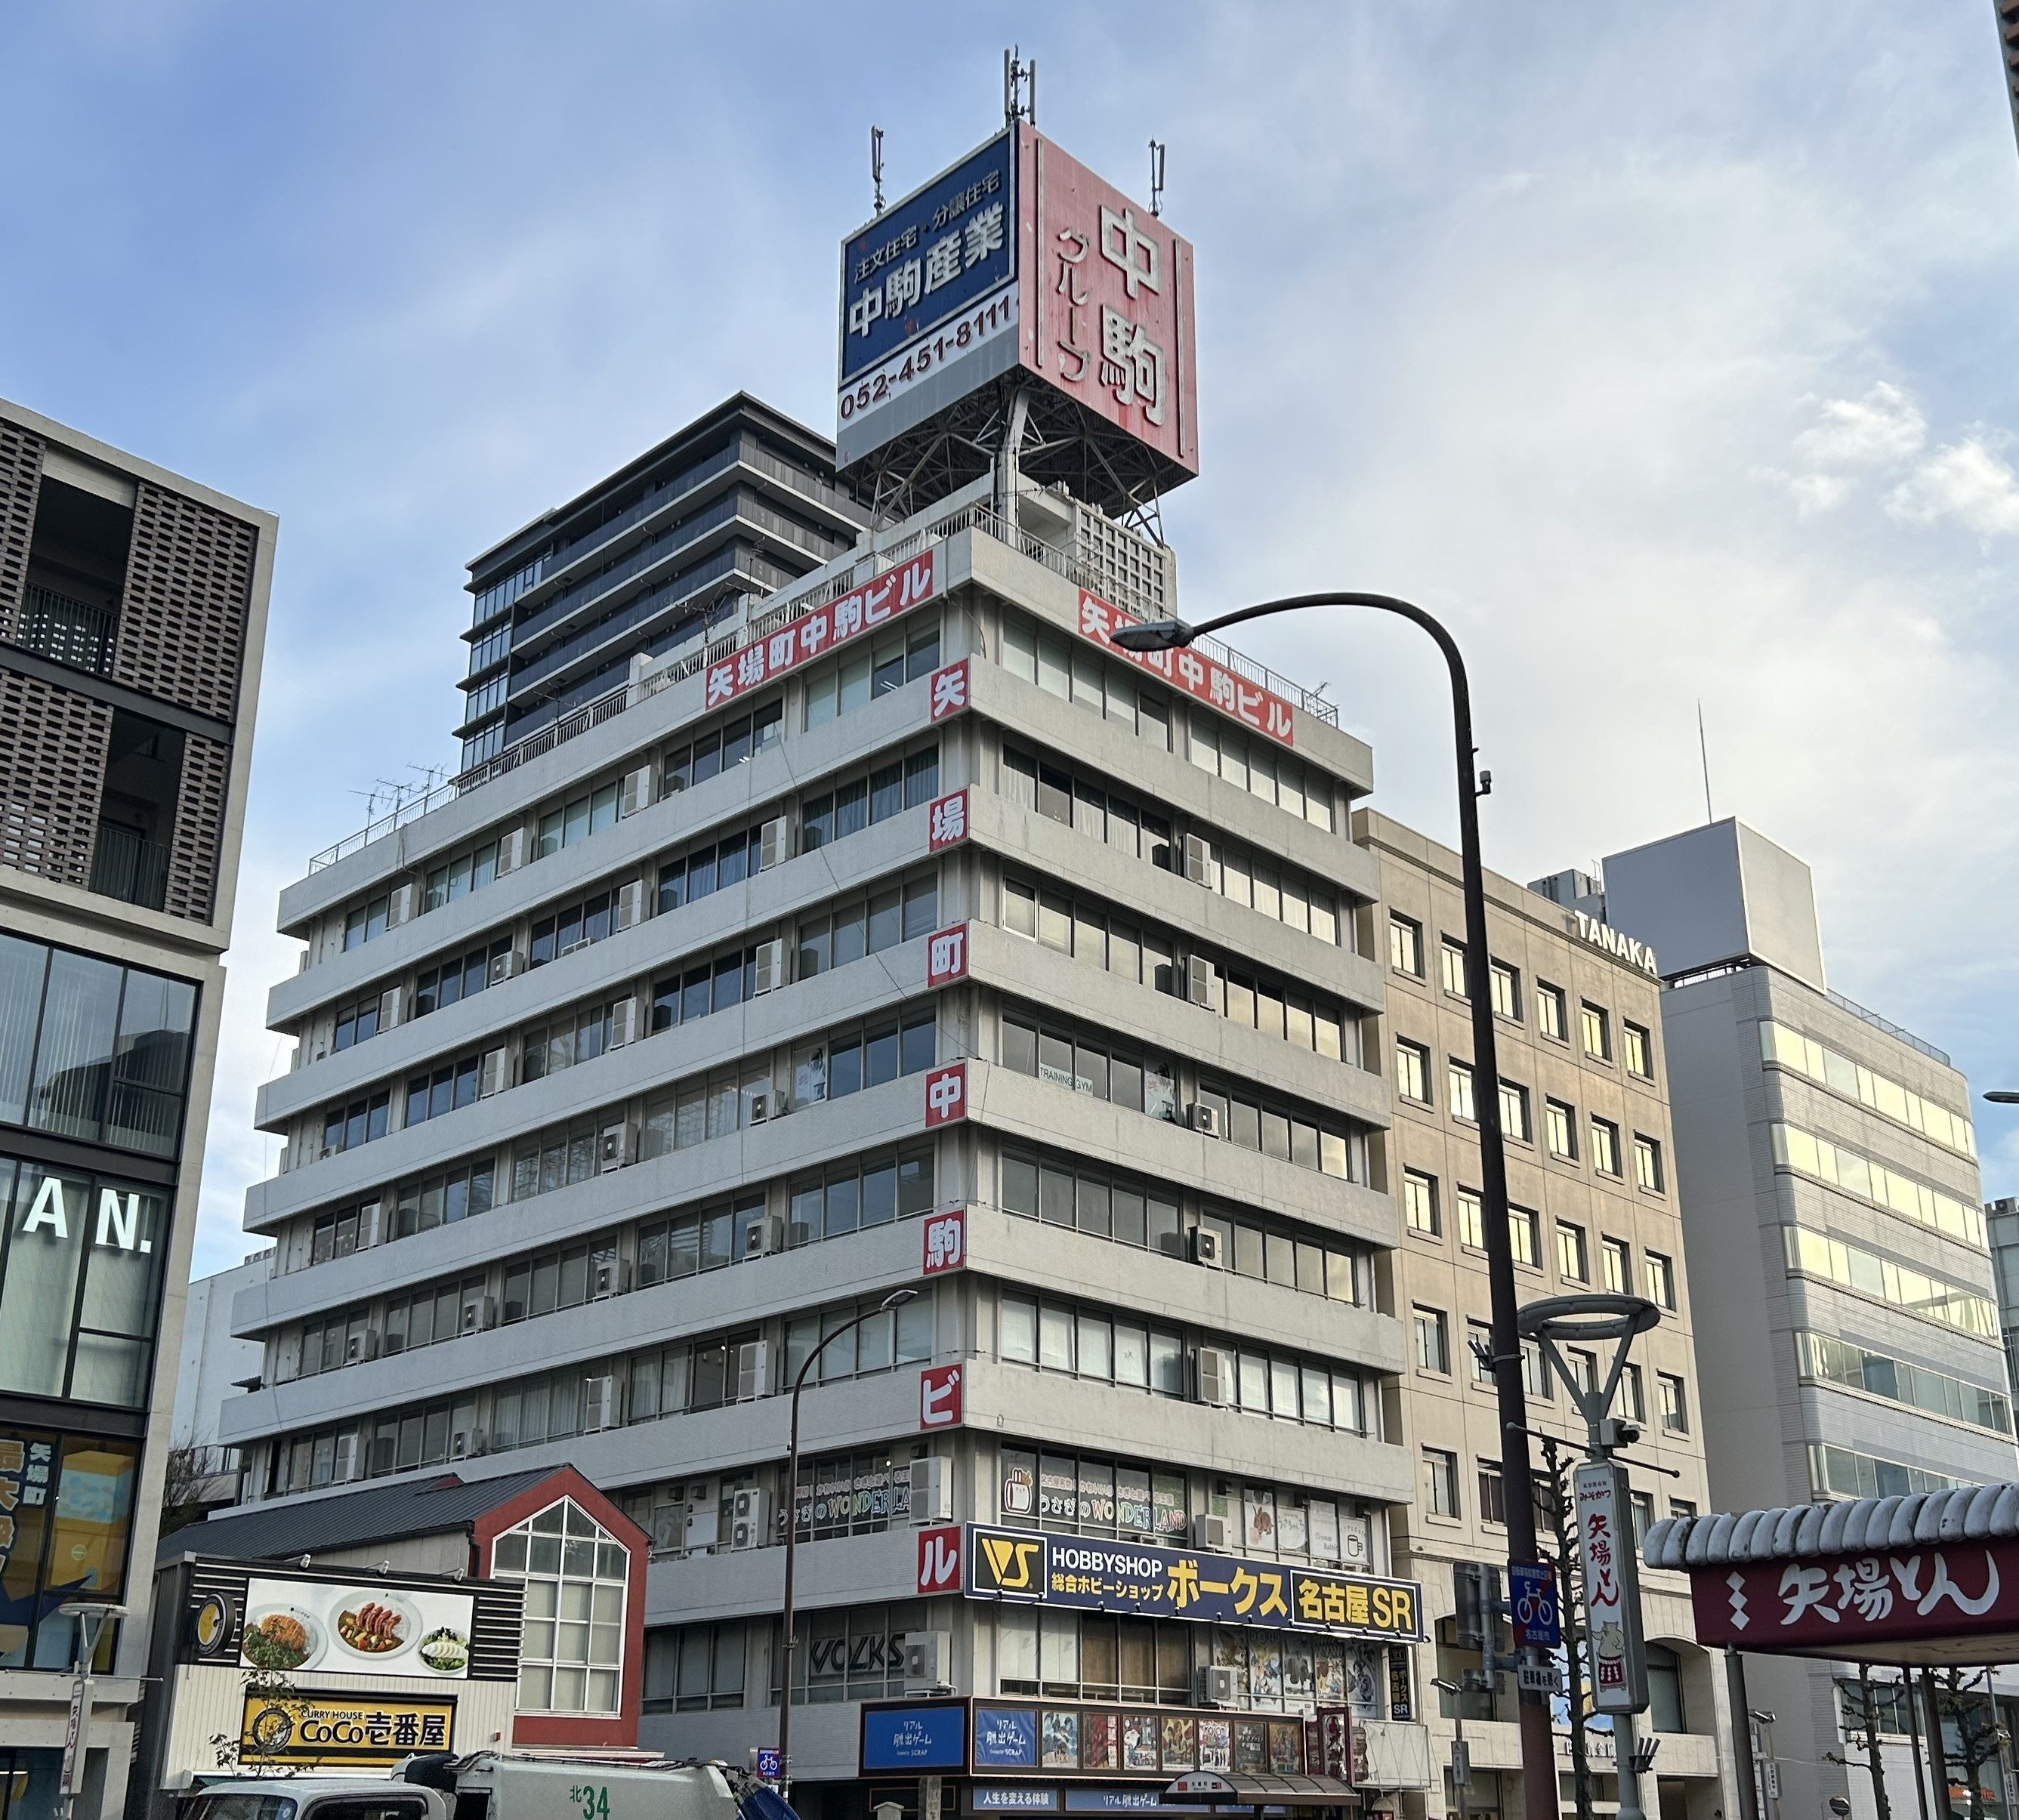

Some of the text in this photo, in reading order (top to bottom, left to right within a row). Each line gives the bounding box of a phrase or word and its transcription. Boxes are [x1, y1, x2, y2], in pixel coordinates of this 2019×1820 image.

[849, 201, 1004, 338] 中駒産業
[1058, 228, 1090, 382] グループ
[1101, 204, 1166, 427] 中駒
[840, 294, 1012, 420] 052-451-8111
[708, 563, 931, 706] 矢場町中駒ビル
[1574, 909, 1658, 974] TANAKA
[1040, 1067, 1093, 1093] TRAINING GYM
[23, 1442, 51, 1505] 矢場町
[1579, 1489, 1611, 1501] みそかつ
[1052, 1547, 1162, 1578] HOBBYSHOP
[1588, 1513, 1619, 1607] 矢場とん
[1051, 1572, 1164, 1602] 総合ホビーショップ
[1167, 1559, 1289, 1618] ボークス
[1777, 1549, 2000, 1626] 矢場とん
[301, 1710, 363, 1720] CURRY HOUSE
[903, 1720, 923, 1731] リアル
[996, 1719, 1017, 1730] リアル
[1394, 1704, 1408, 1714] SR
[300, 1711, 446, 1747] CoCo壱番屋
[893, 1731, 932, 1748] 脱出ゲーム
[986, 1730, 1026, 1746] 脱出ゲーム
[983, 1791, 1049, 1806] 人生を変える体験
